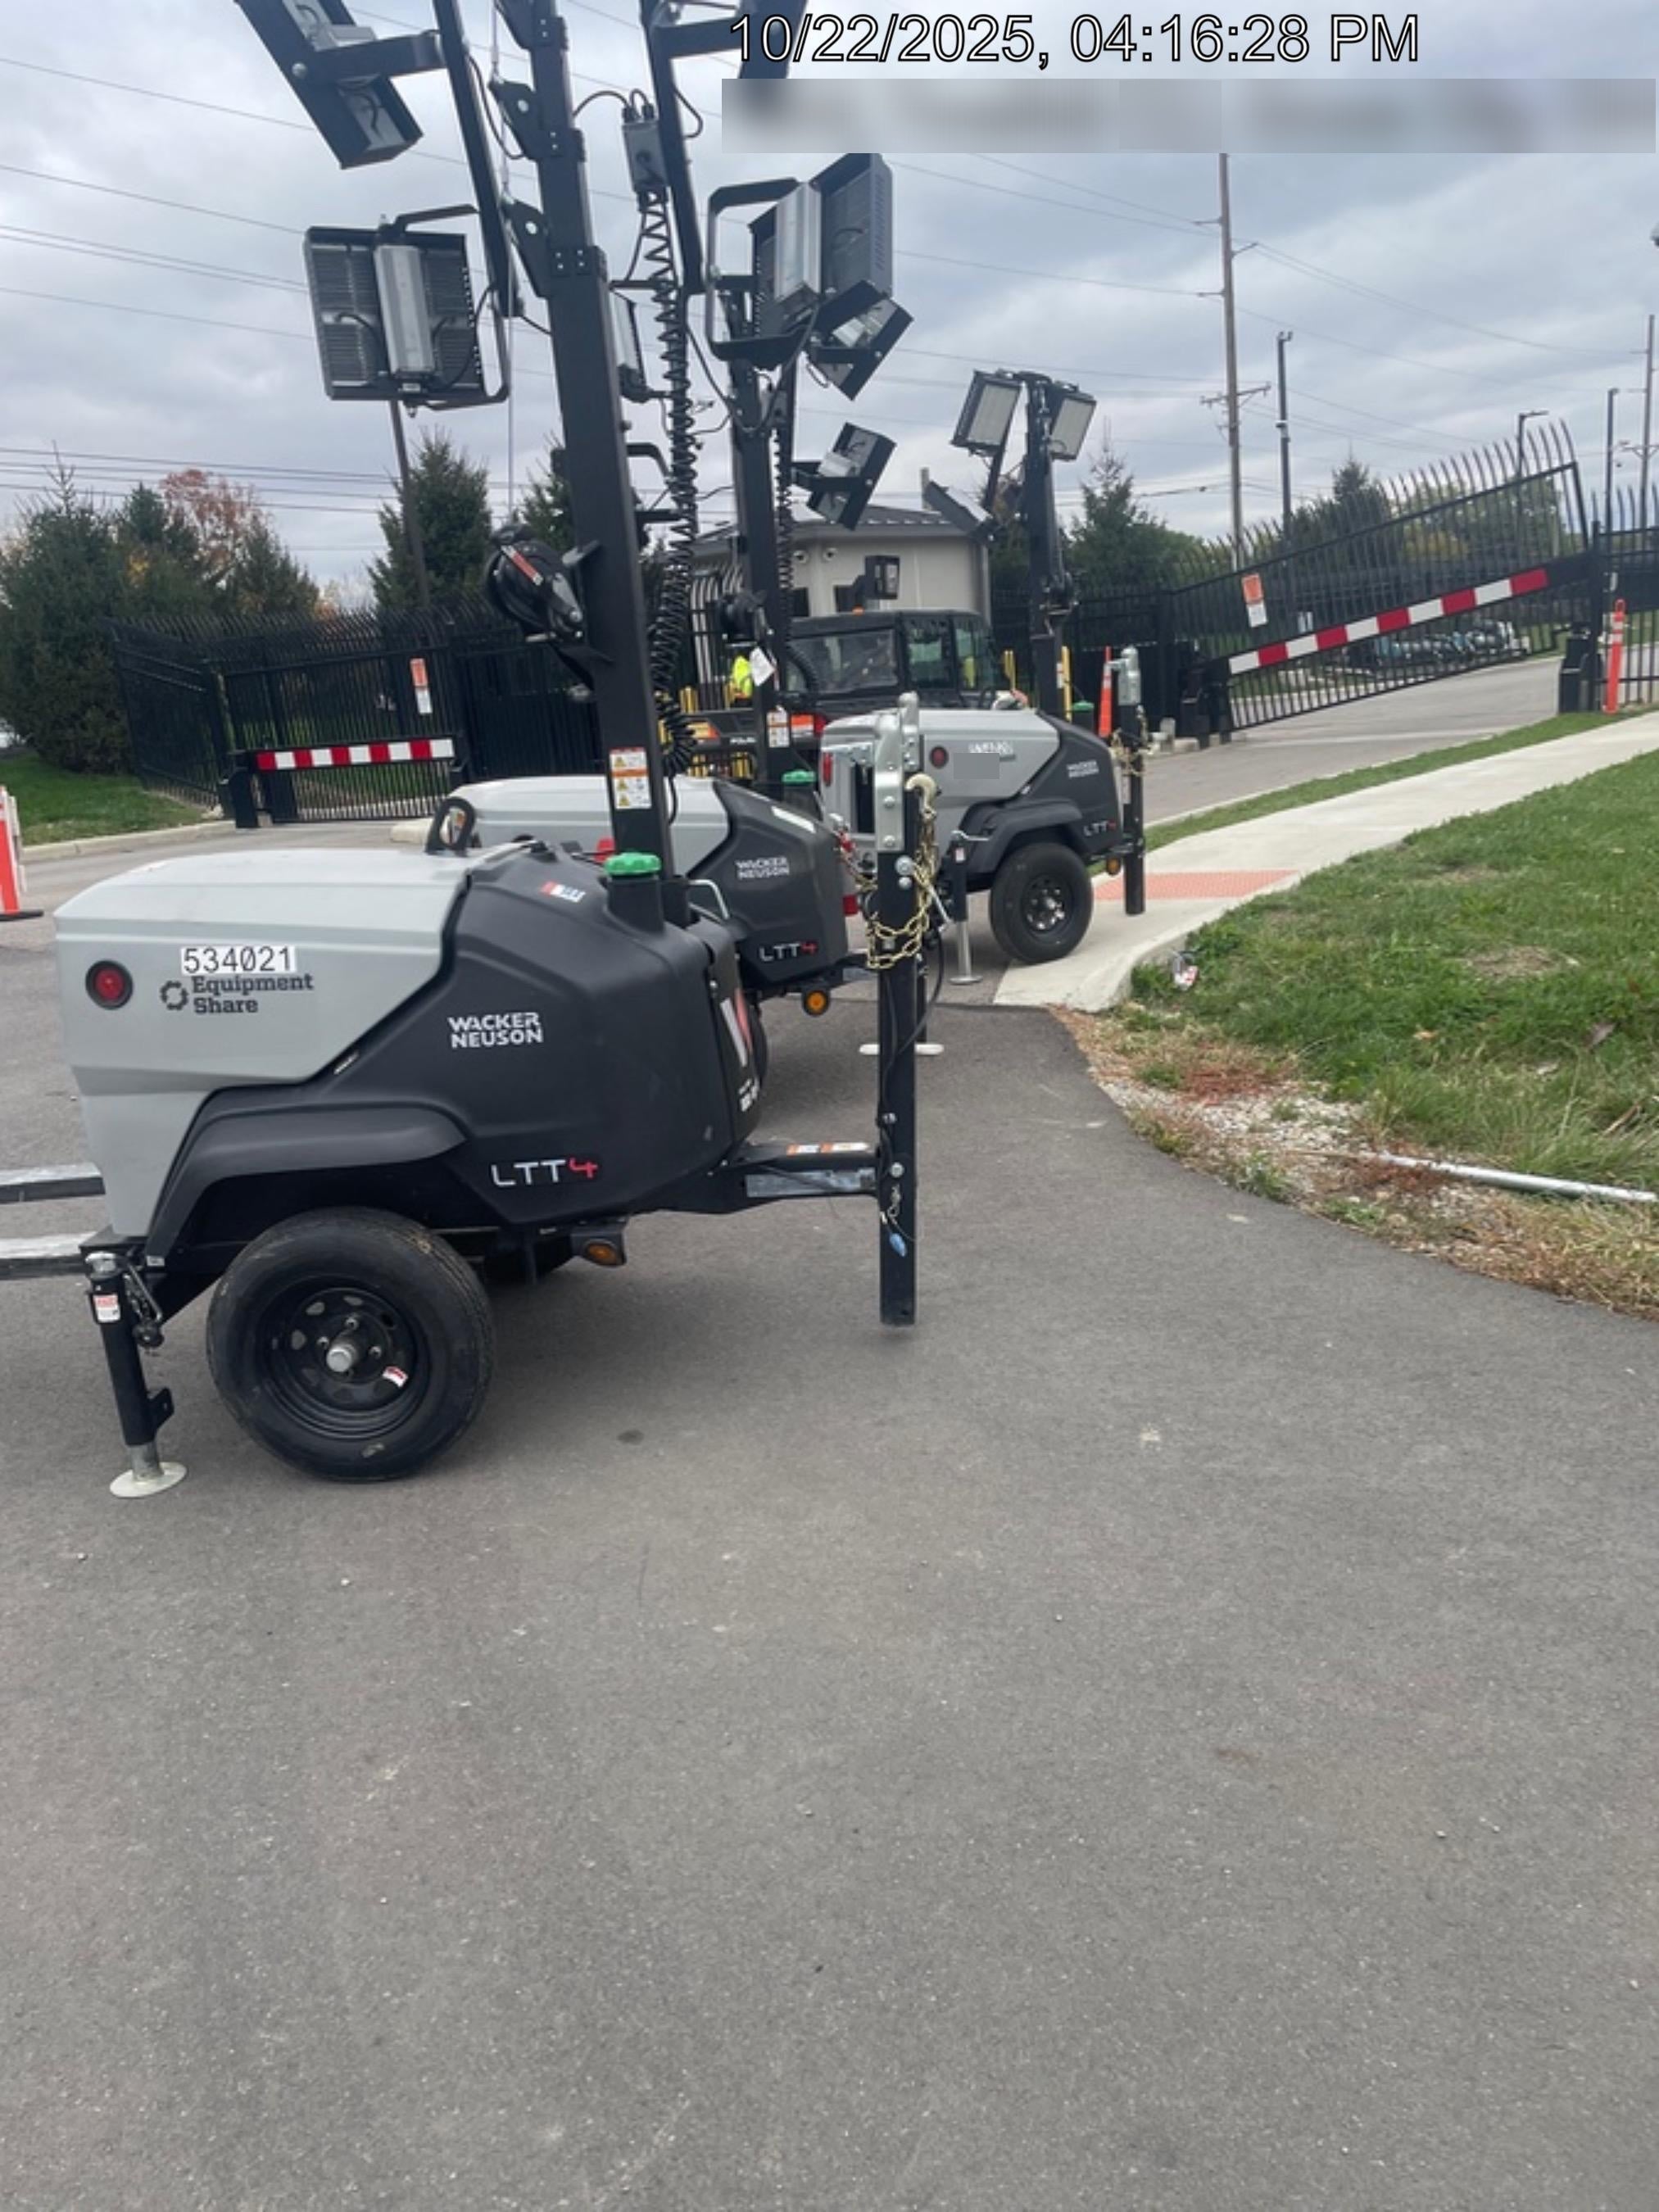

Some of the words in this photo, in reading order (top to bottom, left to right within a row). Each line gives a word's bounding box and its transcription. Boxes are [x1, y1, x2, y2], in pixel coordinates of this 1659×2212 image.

[184, 946, 291, 973] 534021
[759, 940, 817, 962] LTT4
[192, 973, 314, 995] Equipment
[193, 997, 258, 1014] Share
[447, 1012, 542, 1031] WACKER
[451, 1028, 544, 1049] NEUSON
[492, 1158, 598, 1186] LTT4
